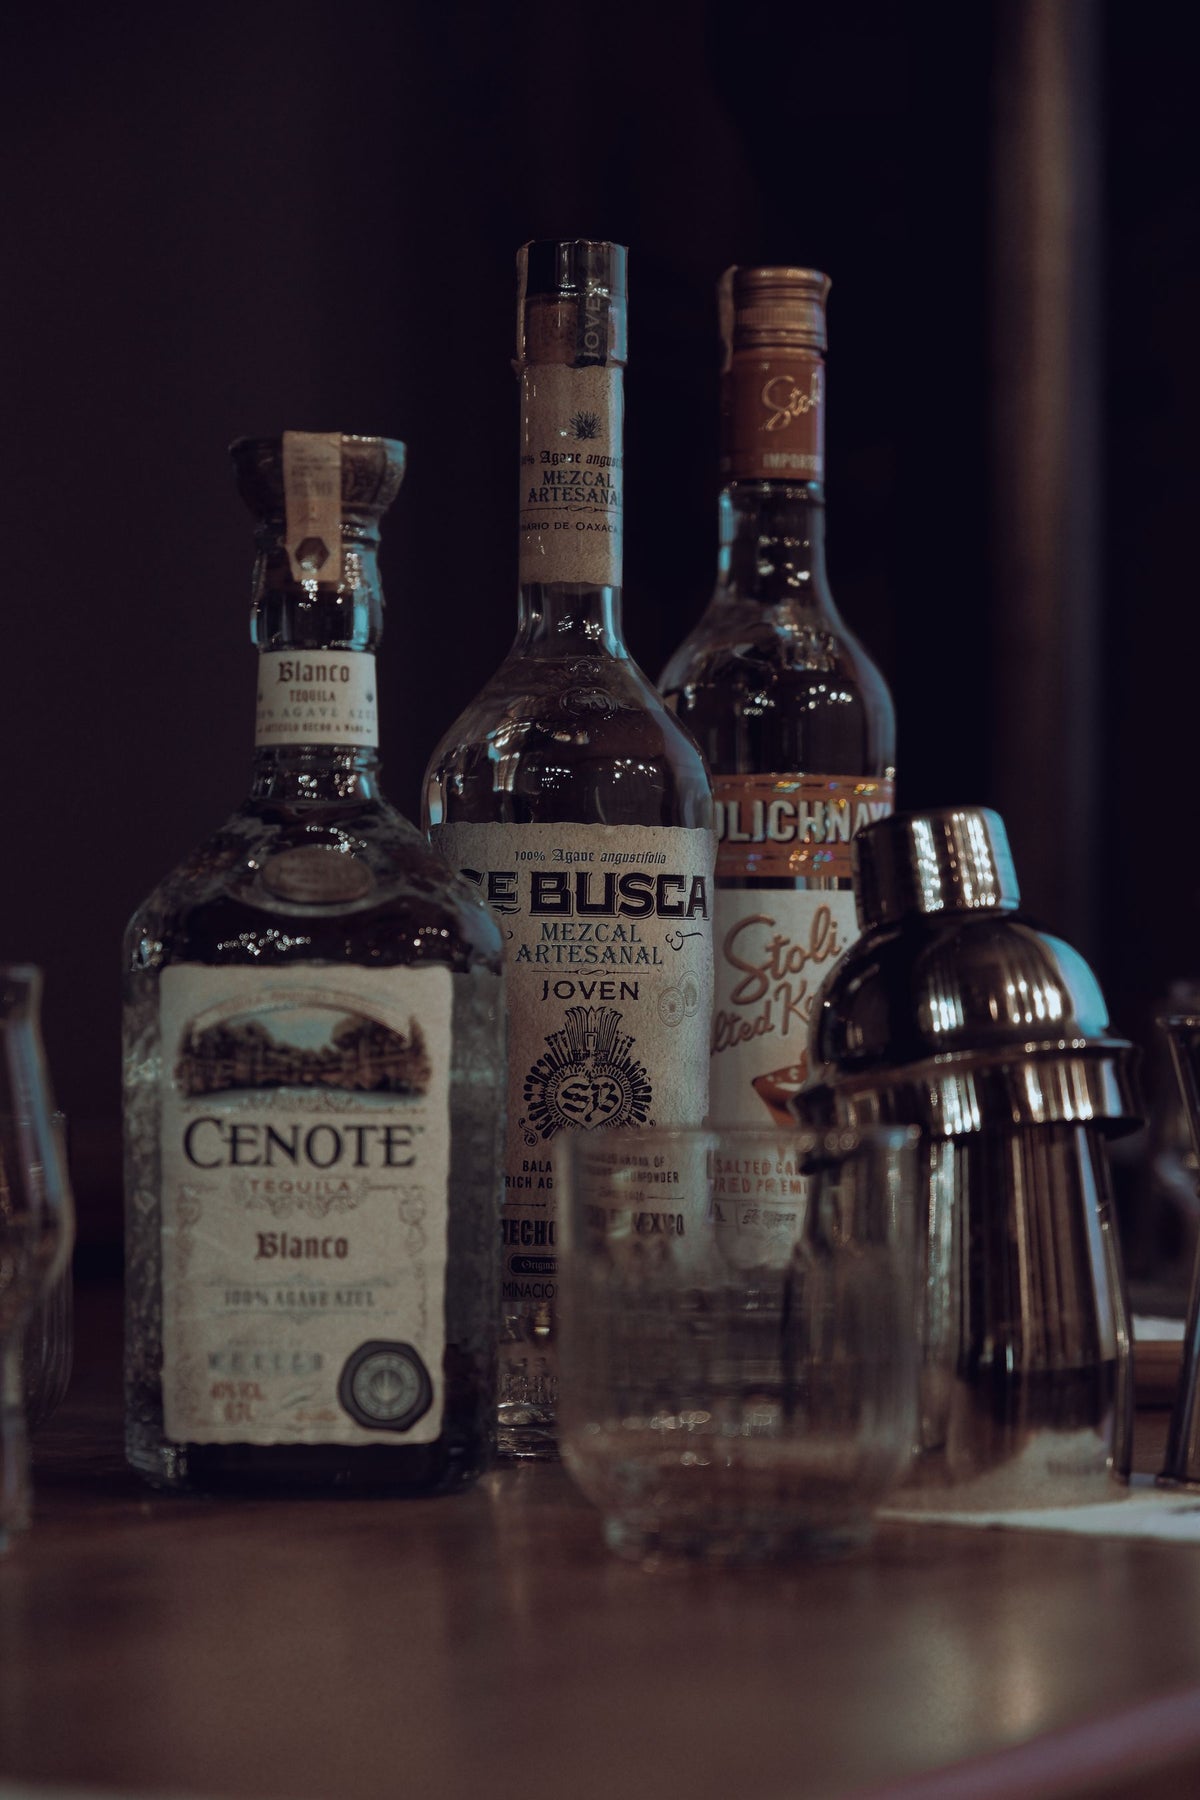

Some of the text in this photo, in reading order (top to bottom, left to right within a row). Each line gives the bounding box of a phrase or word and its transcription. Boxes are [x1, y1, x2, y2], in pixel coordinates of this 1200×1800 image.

[583, 277, 600, 358] JOVEN
[540, 450, 581, 466] Agave
[542, 470, 614, 488] MEZCAL
[554, 522, 569, 530] DE
[277, 661, 350, 683] Blanco
[290, 690, 336, 702] TEQUILA
[514, 849, 667, 864] 100% Agave angustifolia
[528, 870, 709, 920] BUSCA
[540, 923, 642, 943] MEZCAL
[515, 944, 663, 965] ARTESANAL
[541, 980, 640, 1001] JOVEN
[184, 1116, 417, 1169] CENOTE
[714, 1159, 772, 1176] SALTED
[251, 1179, 352, 1194] TEQUILA
[505, 1176, 532, 1188] RICH
[255, 1231, 350, 1260] Blanco
